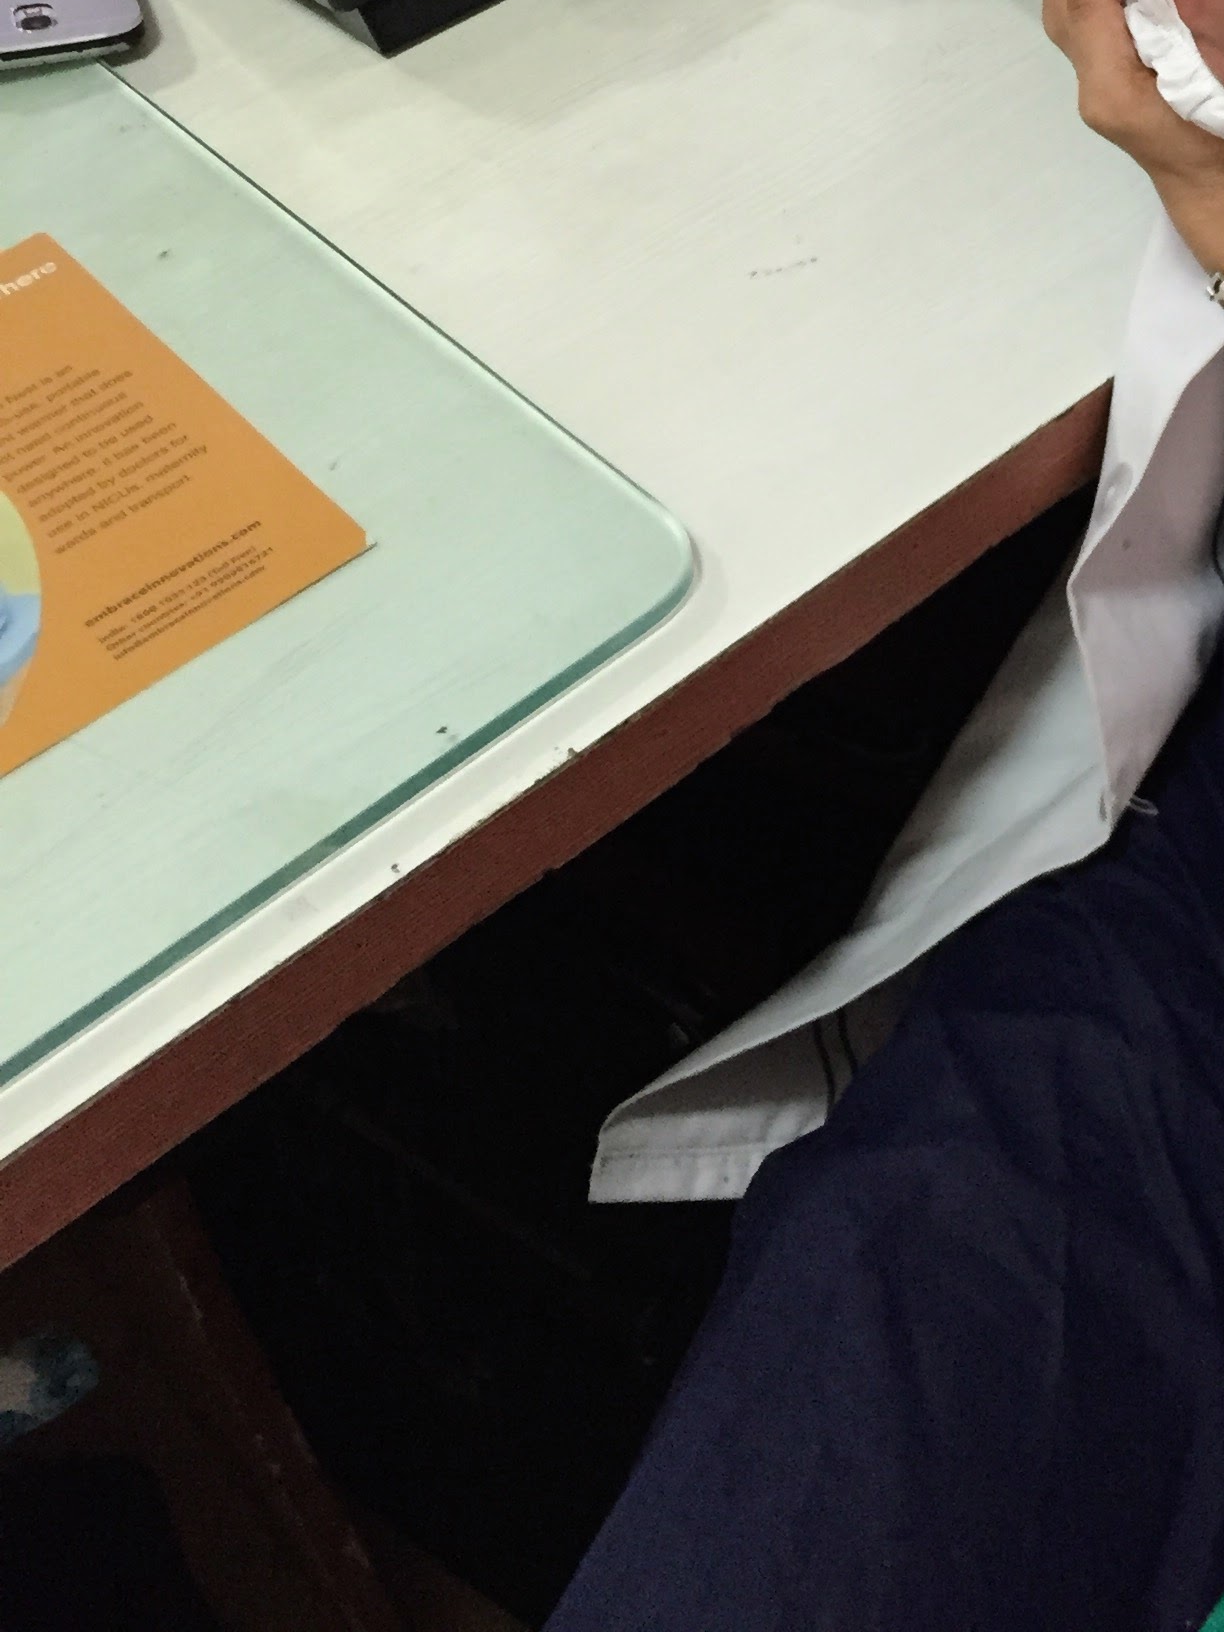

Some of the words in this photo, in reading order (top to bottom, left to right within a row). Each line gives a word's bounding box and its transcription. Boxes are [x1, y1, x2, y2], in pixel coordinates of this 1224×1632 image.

[17, 405, 67, 436] warmer
[70, 388, 97, 407] that
[99, 370, 134, 391] does
[46, 369, 100, 403] portable
[16, 432, 52, 455] need
[53, 391, 128, 434] continuous
[17, 456, 80, 494] designed
[82, 447, 98, 458] to
[98, 435, 118, 449] be
[120, 414, 154, 438] used
[74, 401, 145, 443] innovation
[113, 443, 140, 460] has
[141, 422, 177, 445] been
[39, 486, 96, 522] adopted
[97, 475, 116, 490] by
[118, 446, 169, 478] doctors
[169, 434, 188, 448] for
[48, 520, 73, 538] use
[75, 510, 91, 521] in
[145, 444, 208, 482] maternity
[54, 527, 97, 554] wards
[99, 509, 128, 529] and
[84, 520, 262, 628] embraceinnovations.com
[106, 632, 136, 652] Other
